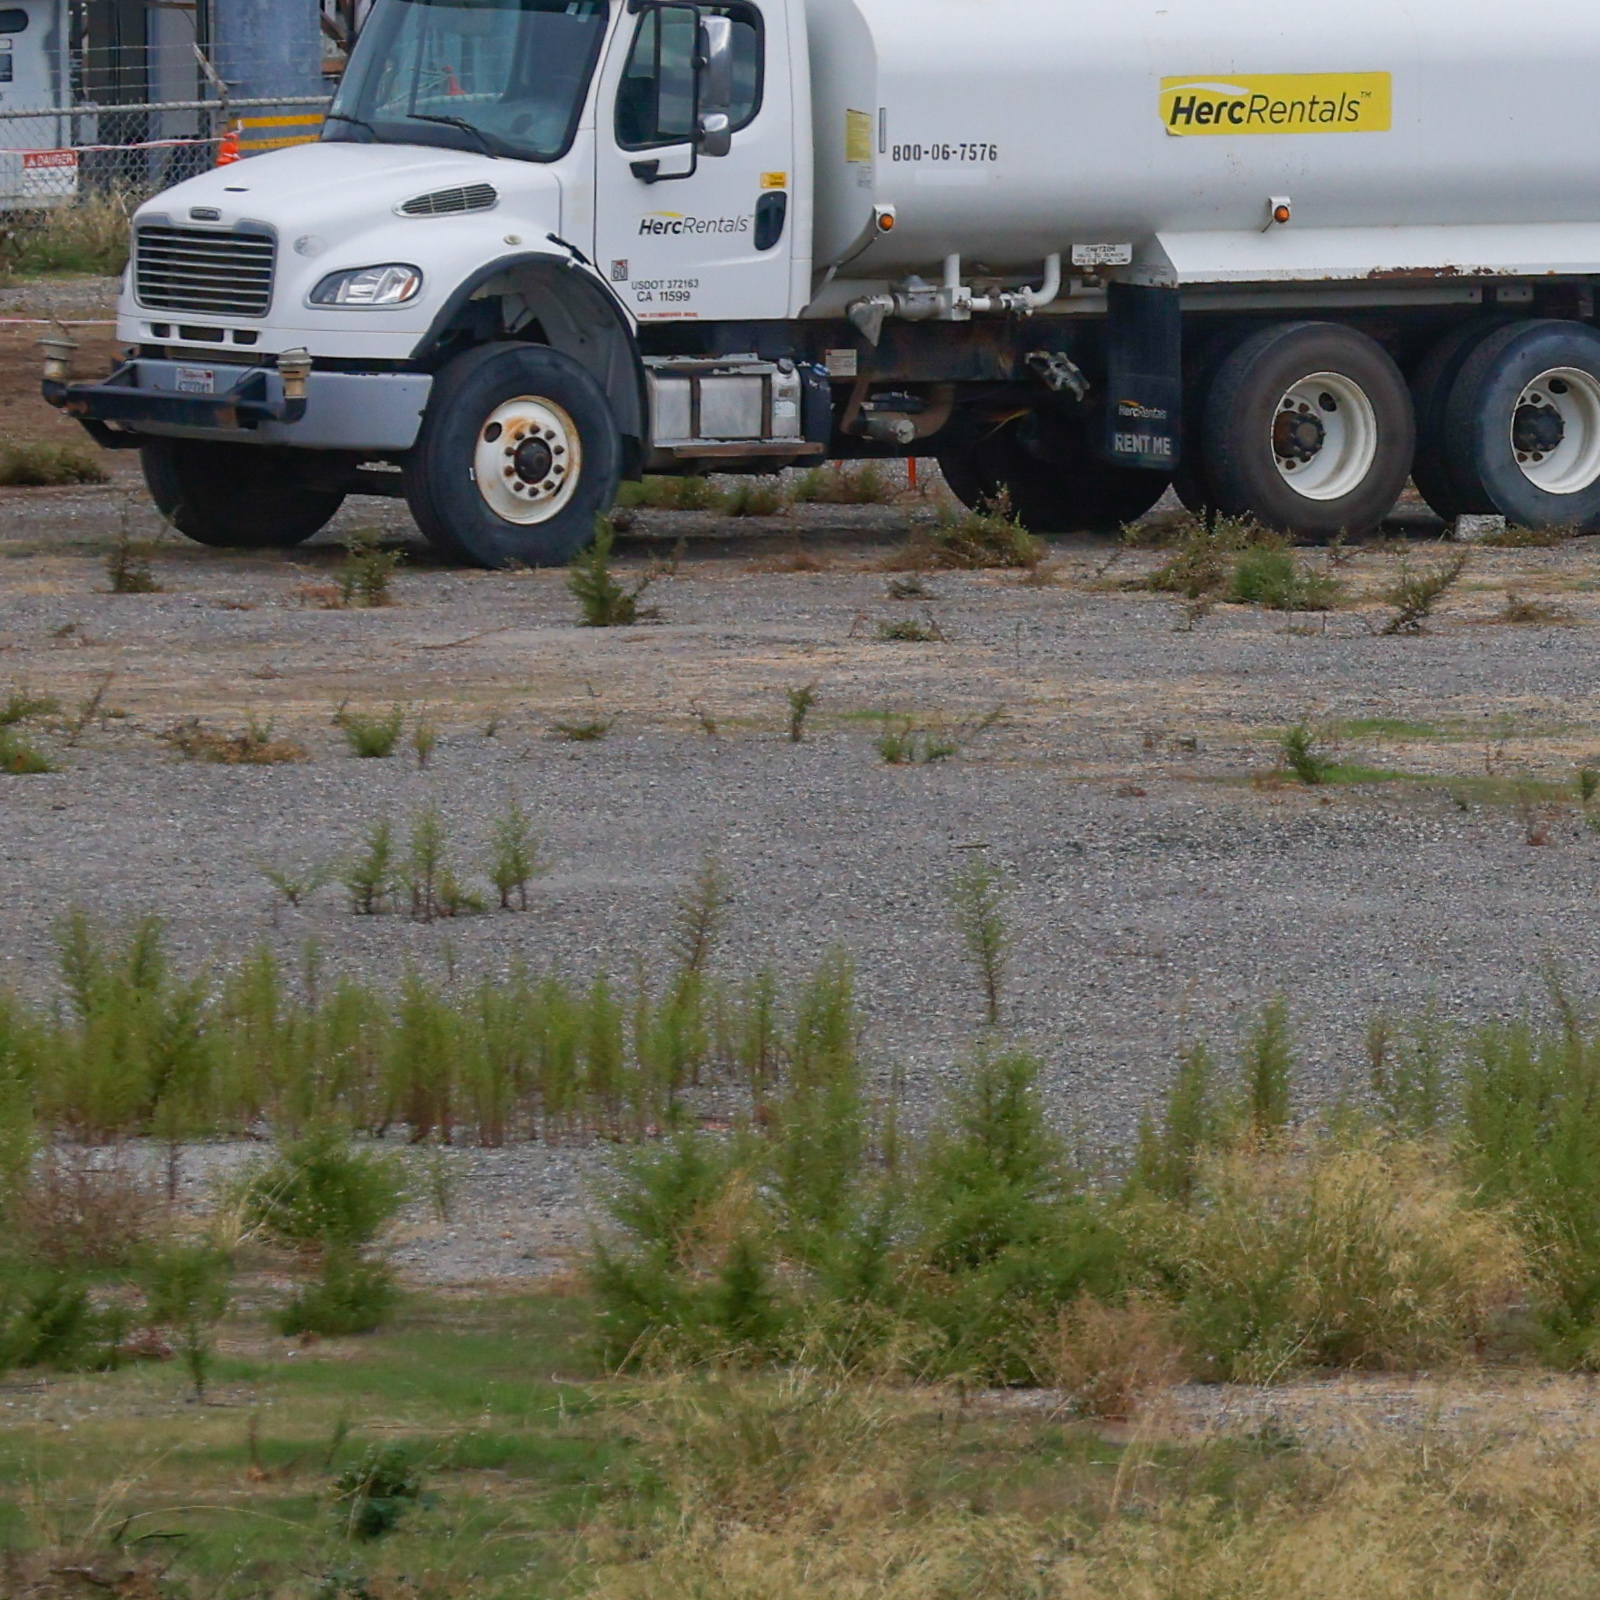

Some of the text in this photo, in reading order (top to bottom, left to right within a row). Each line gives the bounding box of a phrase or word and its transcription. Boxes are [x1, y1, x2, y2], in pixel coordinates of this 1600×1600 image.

[1169, 92, 1361, 125] HercRentals
[37, 153, 74, 167] DANGER
[892, 144, 998, 161] 800-06-7576
[638, 215, 748, 235] HercRentals
[631, 279, 699, 290] USDOT 372163
[636, 290, 691, 302] CA 11599
[1114, 433, 1171, 456] RENT ME
